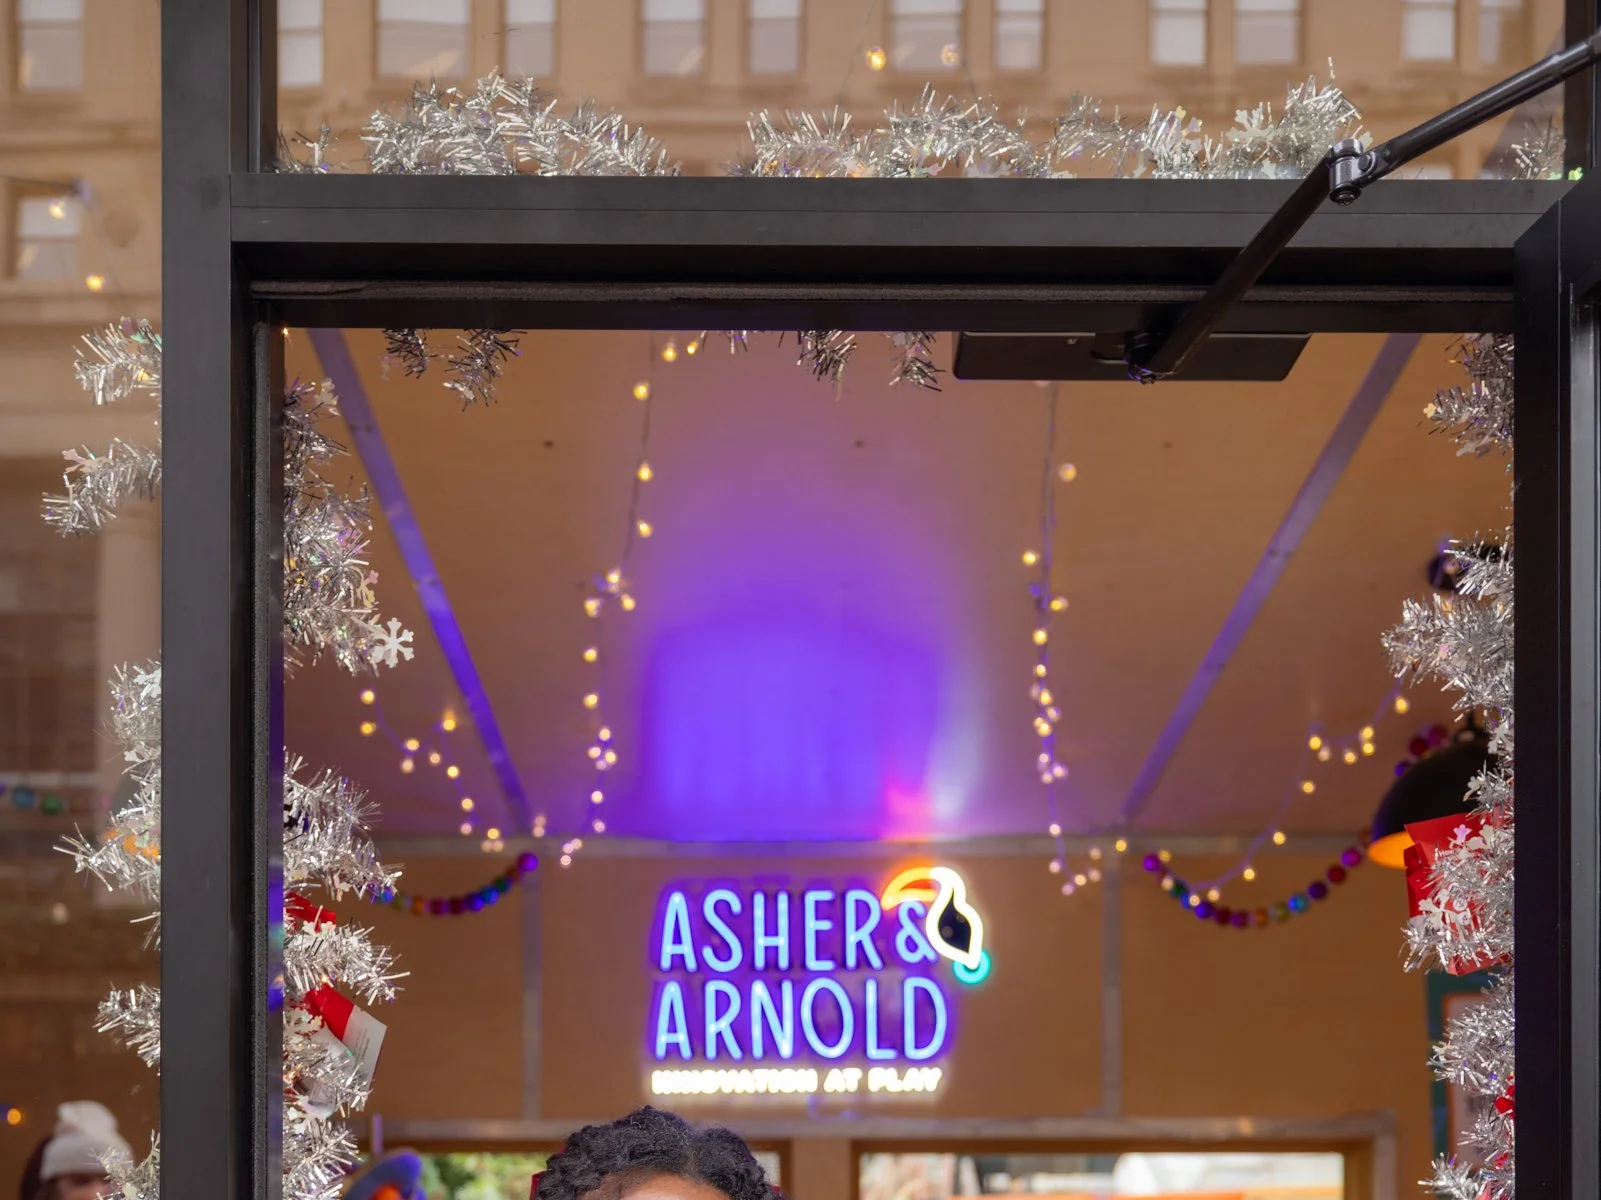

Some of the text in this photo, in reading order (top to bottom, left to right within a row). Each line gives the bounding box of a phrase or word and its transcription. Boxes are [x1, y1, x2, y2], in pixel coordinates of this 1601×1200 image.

[655, 976, 947, 1060] ARNOLD
[824, 1068, 863, 1093] AT
[868, 1067, 942, 1093] PLAY
